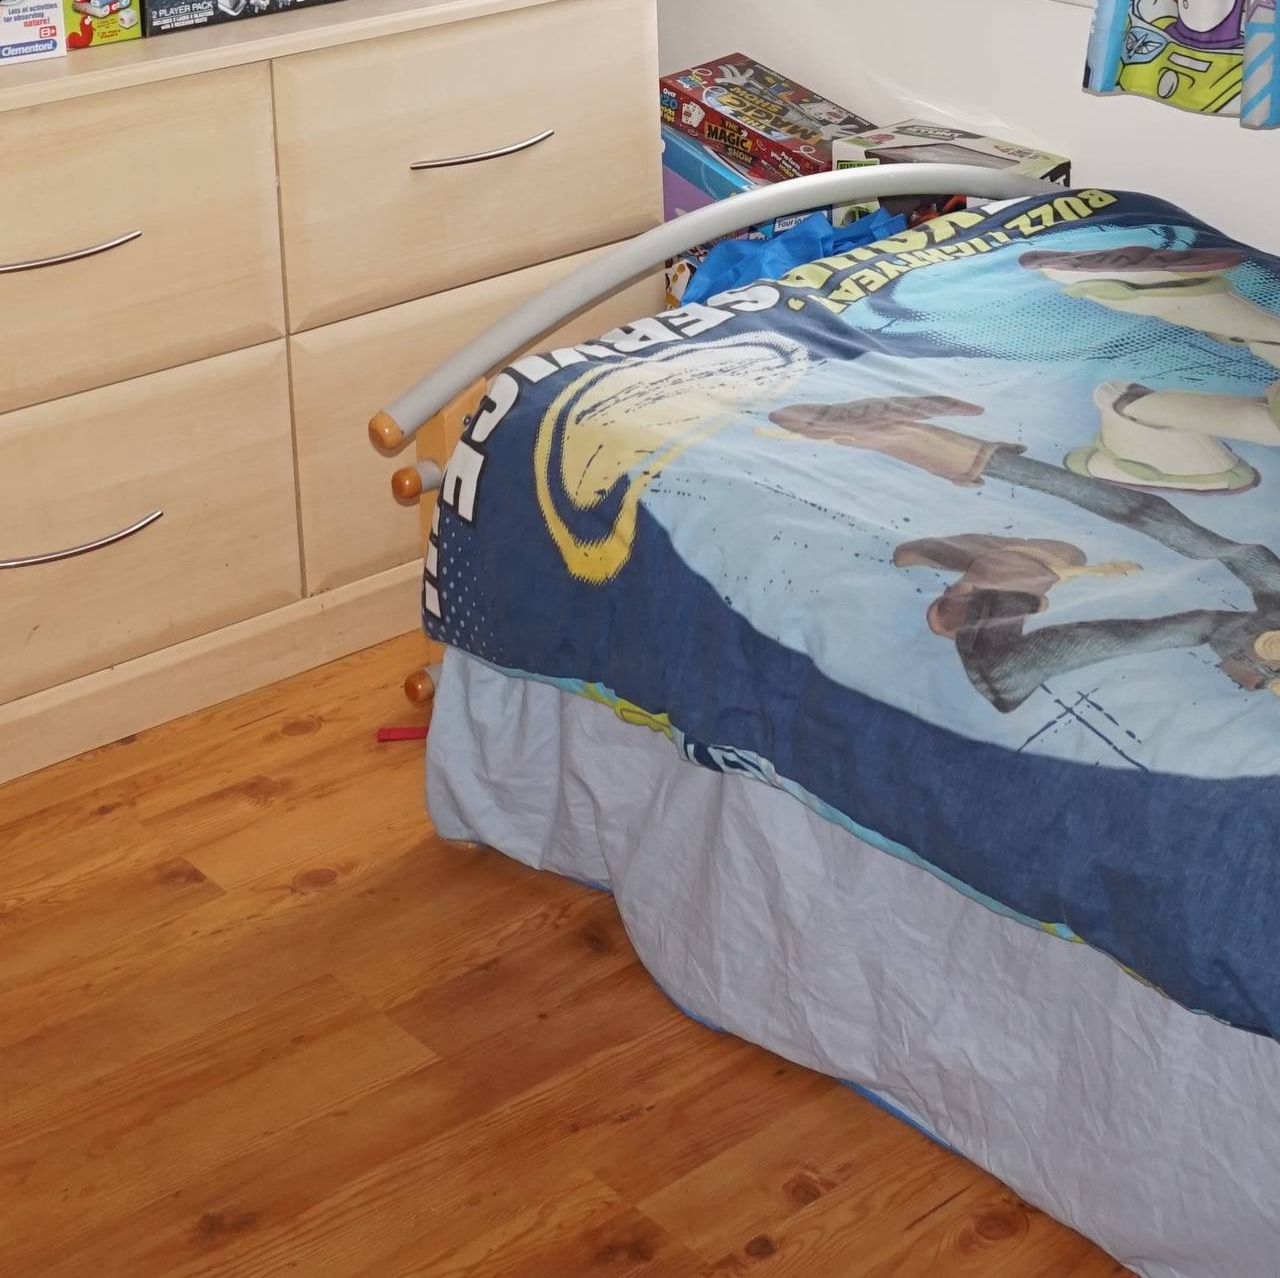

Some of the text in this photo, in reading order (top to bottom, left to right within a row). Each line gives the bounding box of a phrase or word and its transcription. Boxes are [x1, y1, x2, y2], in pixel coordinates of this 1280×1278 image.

[8, 7, 20, 15] Lots
[29, 2, 58, 12] activities
[151, 0, 214, 18] 2 PLAYER PACK
[3, 11, 45, 23] for observing
[23, 18, 50, 28] nature!
[1, 40, 54, 57] Clementoni
[663, 88, 677, 98] Over
[725, 121, 739, 131] THE
[707, 124, 752, 152] MAGIC
[727, 146, 753, 164] SHOW
[1005, 188, 1118, 237] BUZZ
